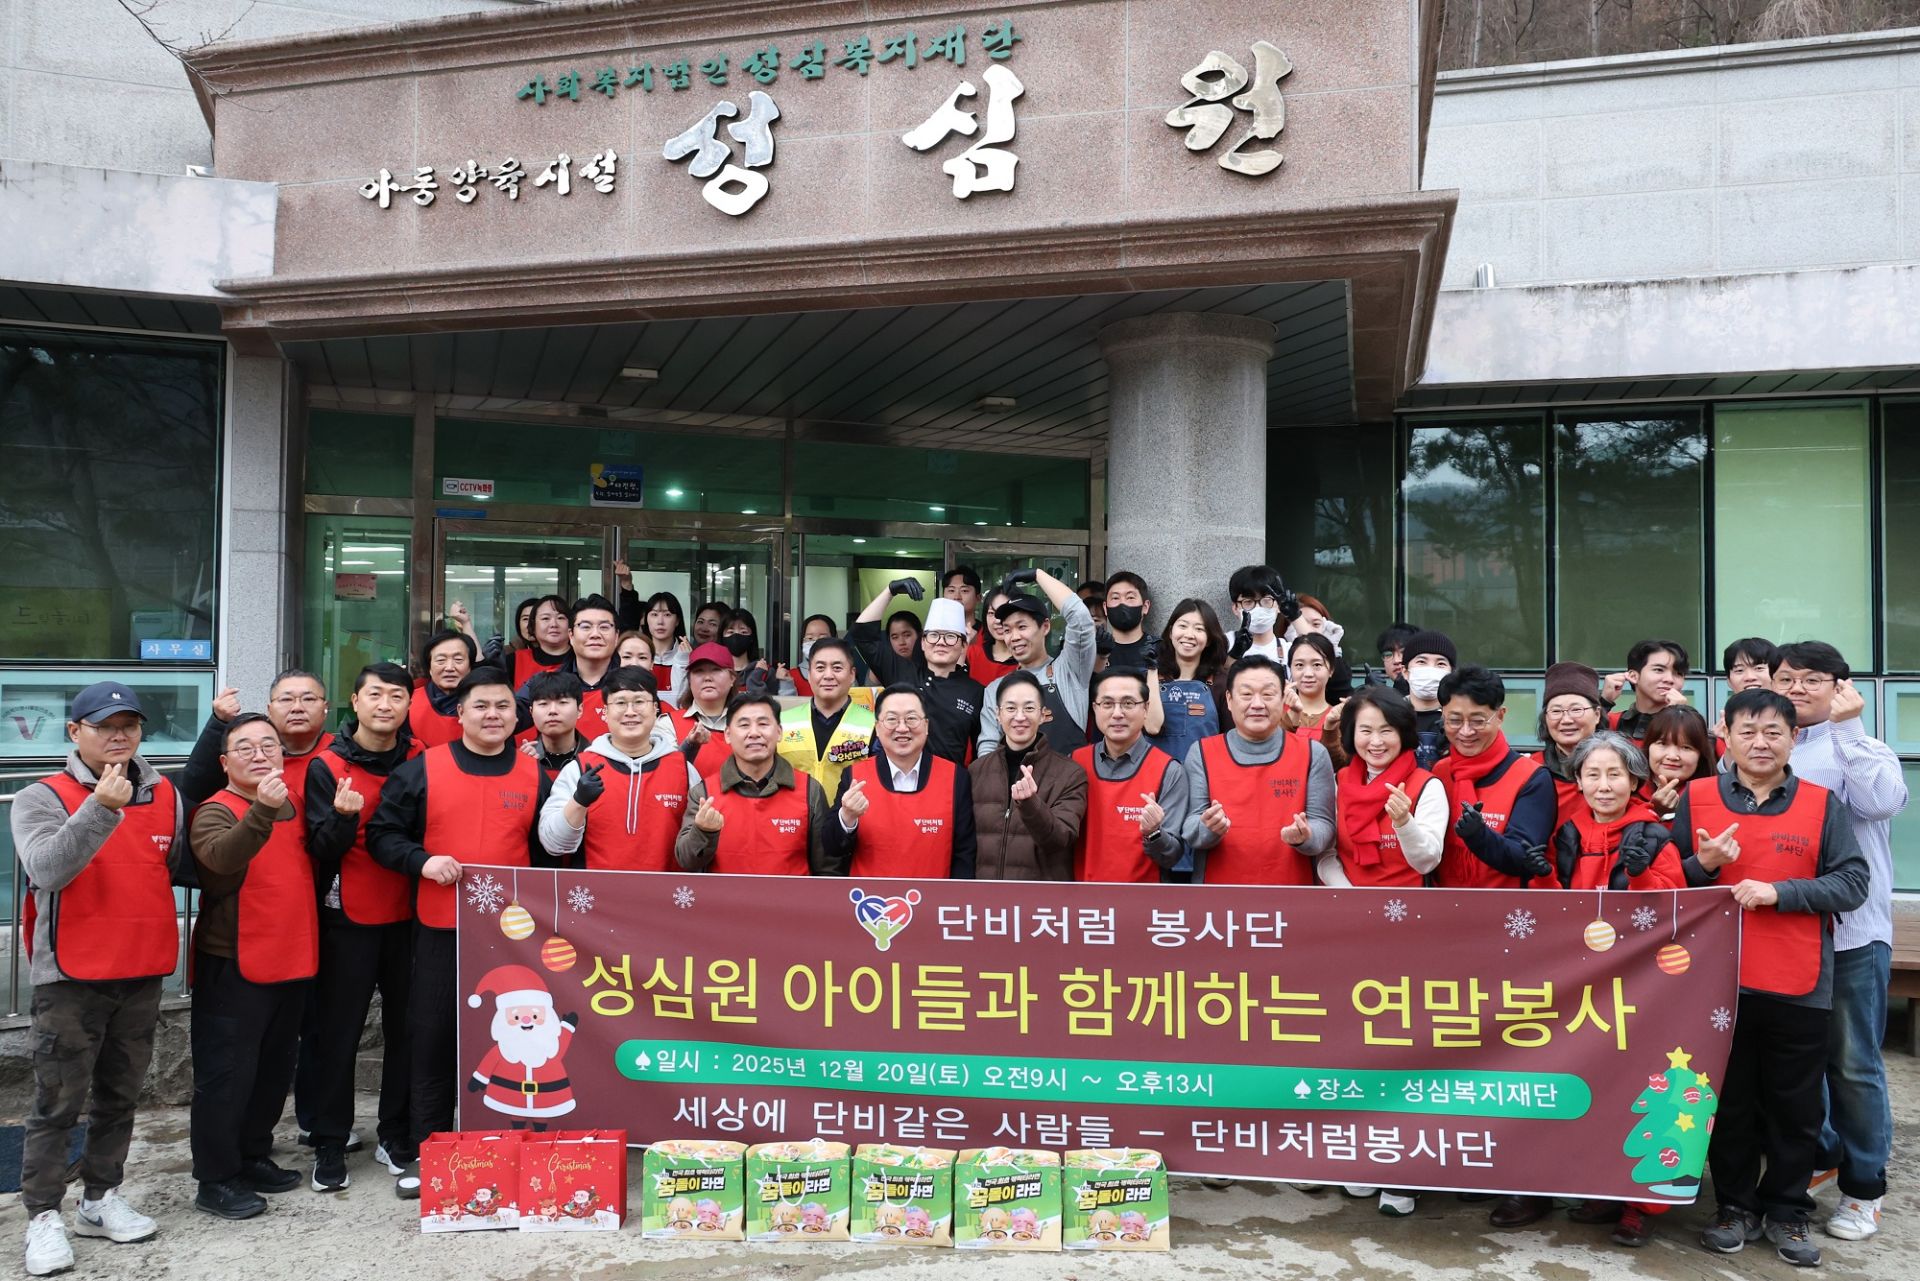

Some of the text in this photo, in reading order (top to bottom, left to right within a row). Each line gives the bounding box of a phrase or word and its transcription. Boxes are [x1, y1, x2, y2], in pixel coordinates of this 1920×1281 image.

[516, 19, 1022, 105] 사회복지법인 성심복지재단
[662, 41, 1293, 217] 성심원
[147, 643, 205, 656] 사무실
[937, 904, 1288, 948] 단비처럼 봉사단
[582, 954, 1638, 1051] 성심원 아이들과 함께하는 연말봉사
[656, 1050, 700, 1073] 일시
[732, 1053, 806, 1078] 2025년
[819, 1060, 864, 1083] 12월
[877, 1062, 970, 1087] 20일(토)
[982, 1065, 1067, 1091] 오전9시
[1116, 1070, 1214, 1098] 오후13시
[1316, 1078, 1365, 1101] 장소
[1401, 1078, 1558, 1108] 성심복지재단
[673, 1096, 787, 1134] 세상에
[812, 1101, 970, 1141] 단비같은
[992, 1111, 1115, 1149] 사람들
[1191, 1118, 1498, 1169] 단비처럼봉사단
[449, 1152, 494, 1172] Christmas
[548, 1153, 592, 1172] Christmas
